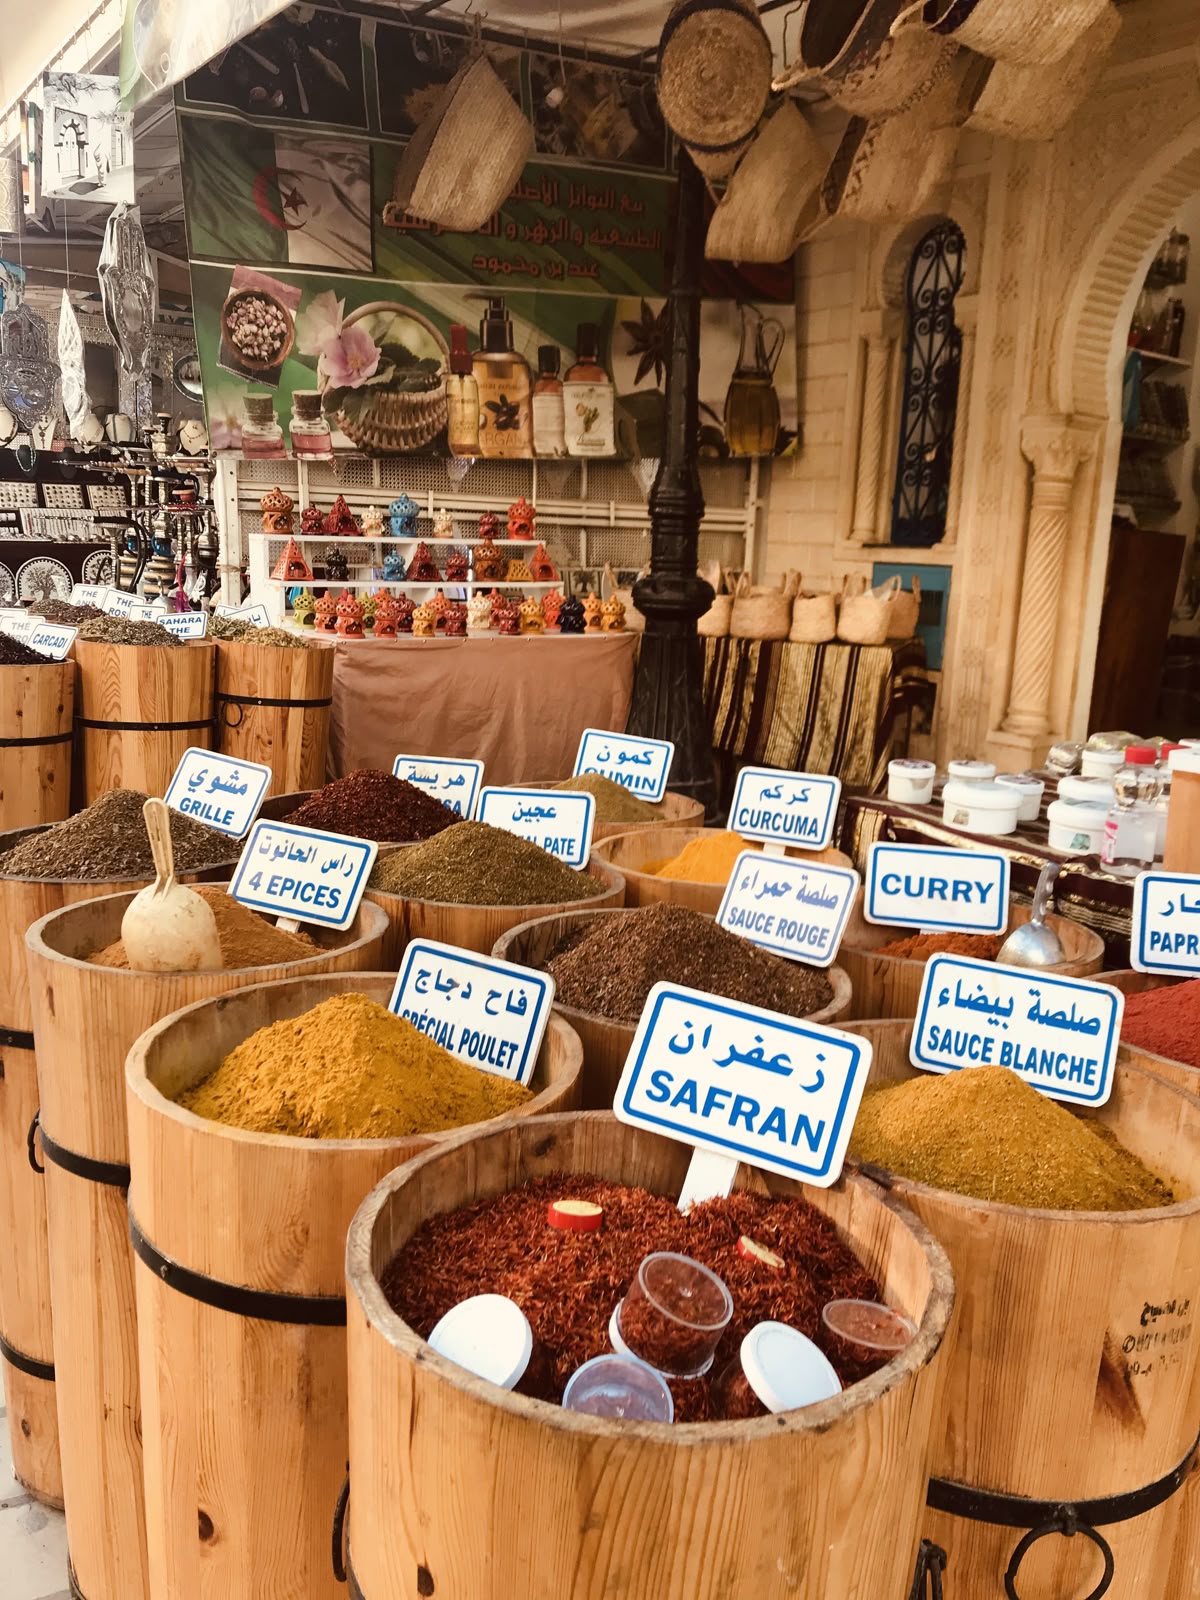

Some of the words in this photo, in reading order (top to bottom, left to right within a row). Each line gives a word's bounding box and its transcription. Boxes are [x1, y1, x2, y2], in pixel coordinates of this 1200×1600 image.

[159, 617, 202, 625] SAHARA
[32, 633, 69, 649] CARCADI
[596, 745, 655, 765] كمون
[188, 767, 249, 796] مشوي
[407, 763, 466, 789] هريسة
[760, 784, 811, 805] كركم
[179, 797, 235, 826] GRILLE
[512, 801, 557, 821] عجين
[738, 808, 818, 838] CURCUMA
[258, 835, 318, 864] الحانوت
[544, 836, 576, 856] PATE
[248, 871, 264, 891] 4
[266, 875, 342, 909] EPICES
[740, 869, 793, 900] حمراء
[796, 875, 839, 910] صلصة
[880, 873, 995, 904] CURRY
[727, 906, 776, 935] SAUCE
[776, 918, 830, 949] ROUGE
[414, 967, 473, 1002] دجاج
[484, 988, 528, 1016] فاح
[937, 978, 1015, 1030] بيضاء
[1026, 987, 1102, 1036] صلصة
[457, 1027, 519, 1070] POULET
[668, 1020, 826, 1093] زعفران
[927, 1024, 995, 1063] SAUCE
[999, 1041, 1098, 1086] BLANCHE
[645, 1069, 826, 1153] SAFRAN
